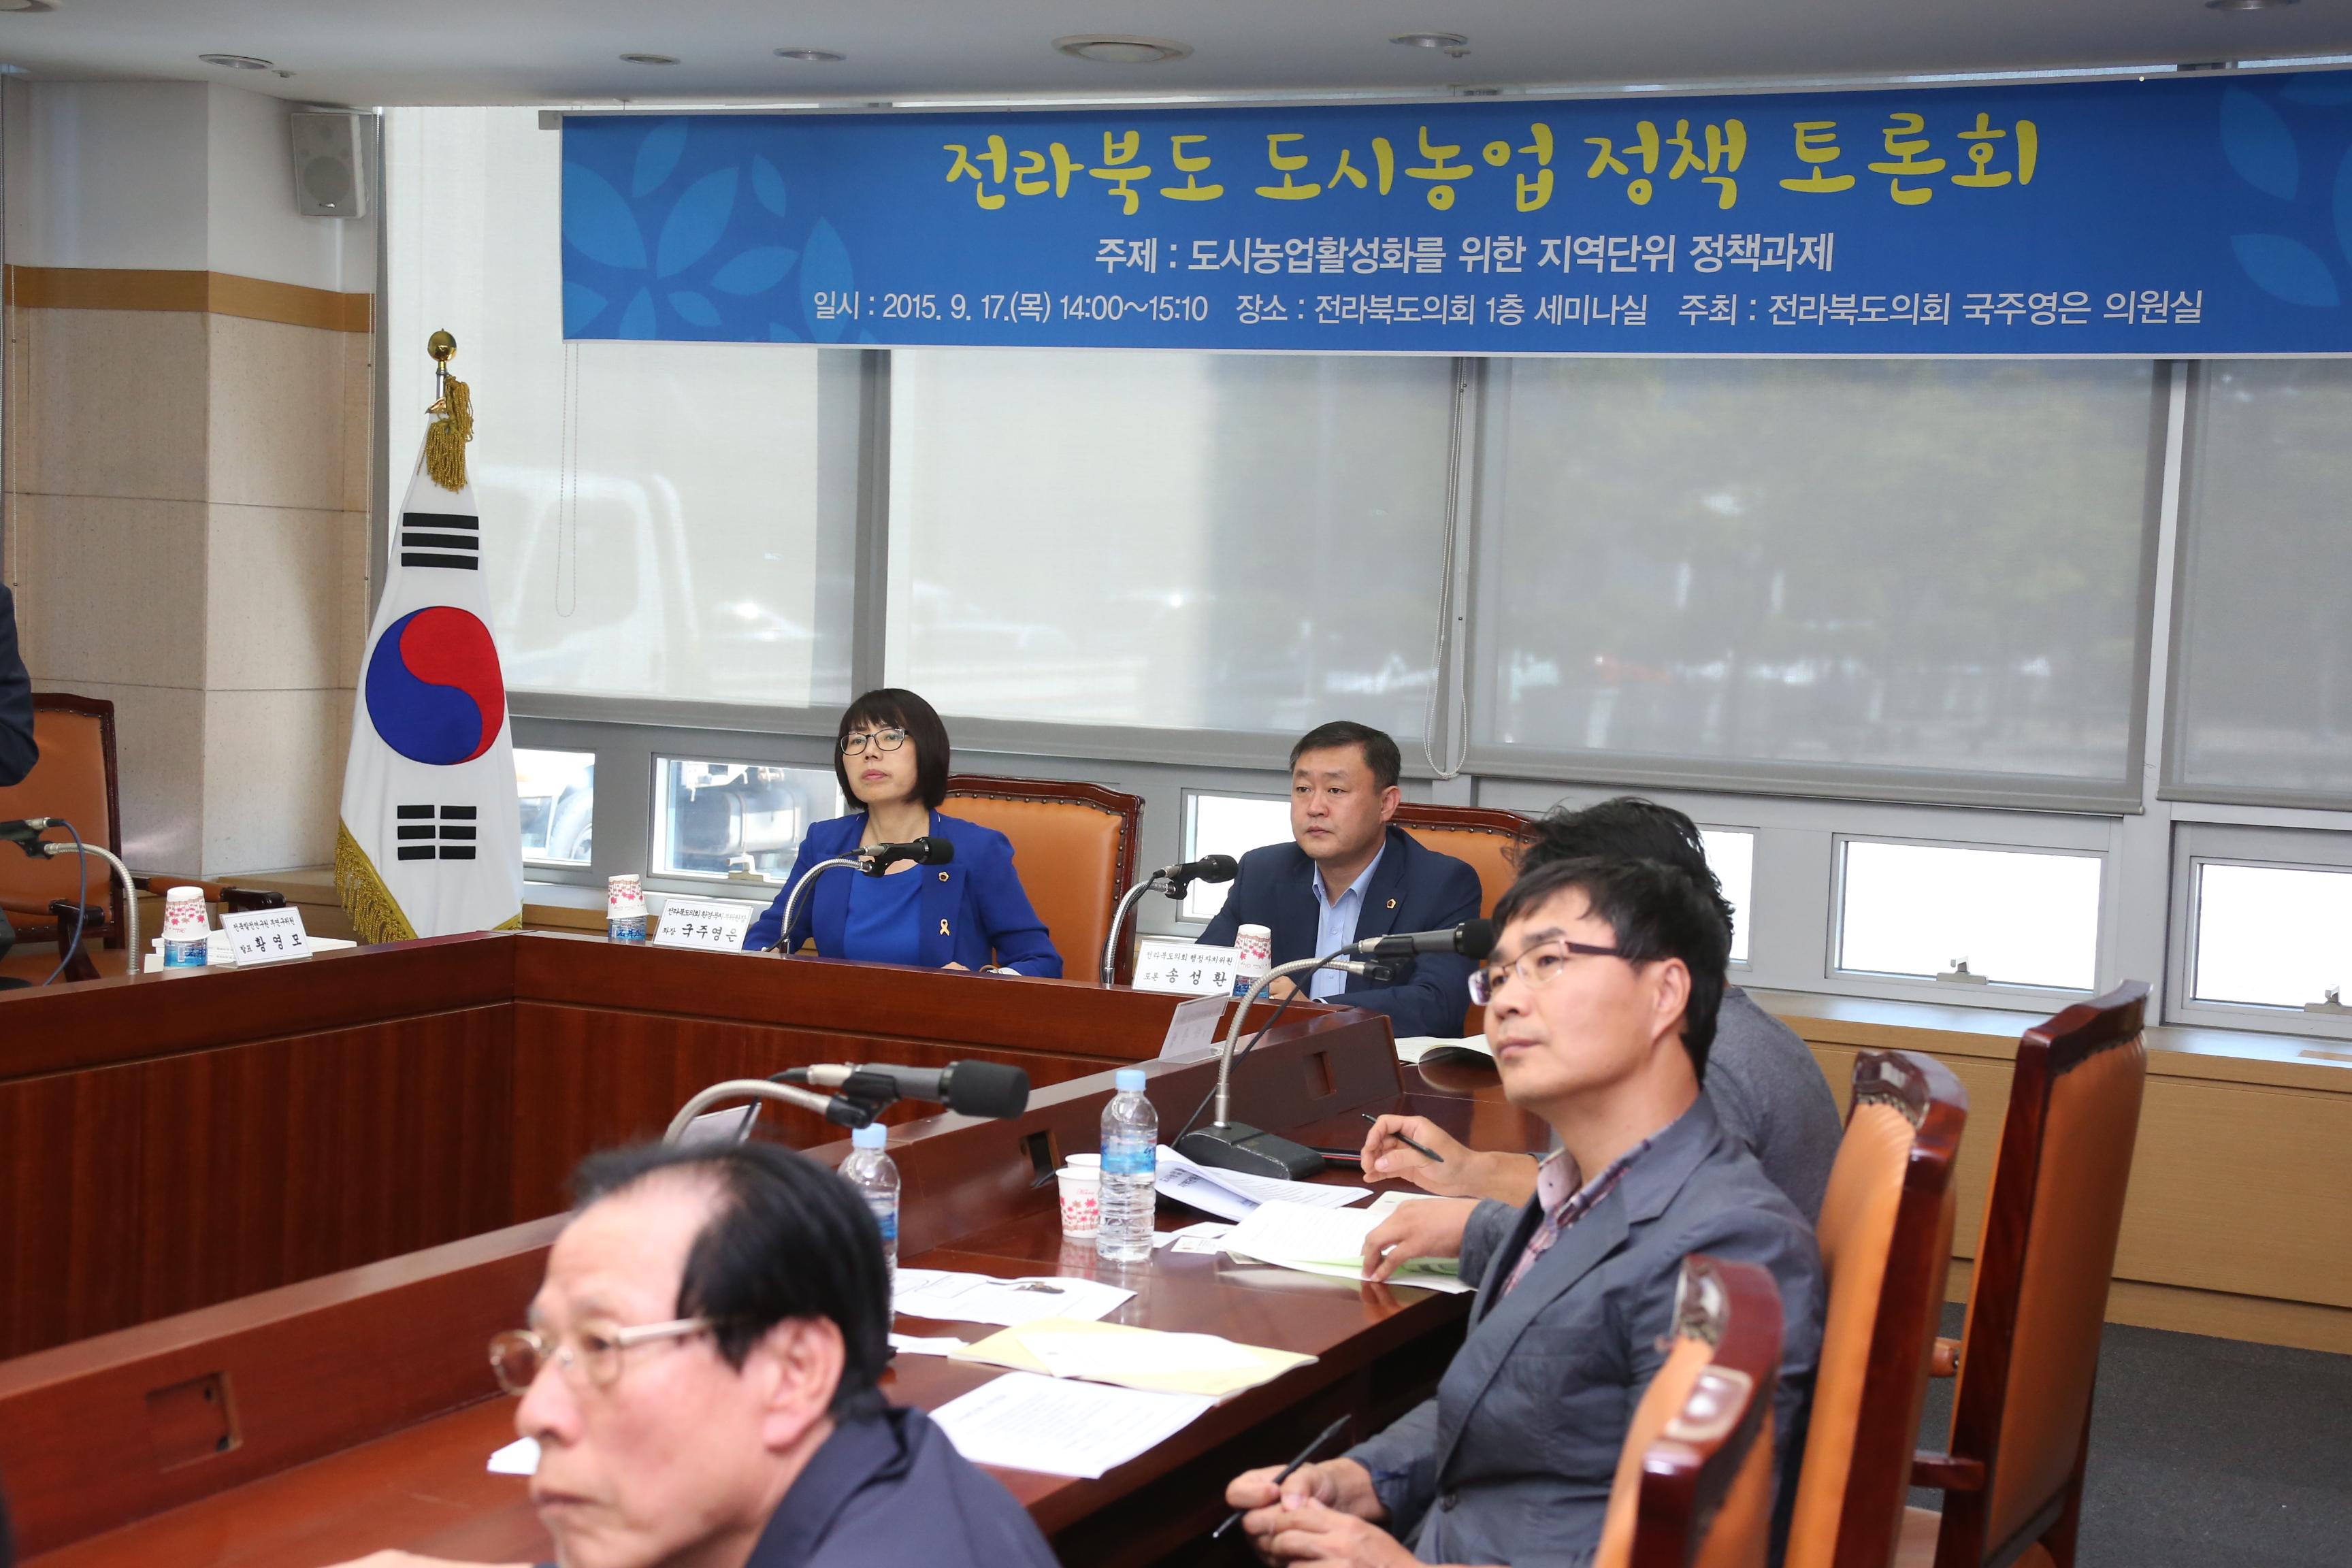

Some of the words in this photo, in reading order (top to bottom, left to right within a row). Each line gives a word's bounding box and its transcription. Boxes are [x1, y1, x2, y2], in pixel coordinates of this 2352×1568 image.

[943, 130, 1224, 215] 전라북도
[1256, 122, 1554, 212] 도시농업
[1584, 118, 1747, 210] 정책
[1779, 112, 2038, 206] 토론회
[1096, 238, 1158, 274] 주제
[1188, 237, 1448, 275] 도시농업활성화를
[1459, 236, 1527, 274] 위한
[1538, 235, 1676, 274] 지역단위
[1690, 233, 1835, 274] 정책과제
[814, 291, 860, 321] 일시
[883, 293, 942, 321] 2015.
[951, 294, 972, 321] 9.
[981, 291, 1051, 324] 17.(목)
[1060, 295, 1209, 322] 14:00~15:10
[1237, 294, 1289, 325] 장소
[1316, 295, 1475, 326] 전라북도의회
[1486, 294, 1526, 327] 1층
[1535, 295, 1648, 326] 세미나실
[1679, 294, 1737, 327] 주최
[1769, 293, 1951, 327] 전라북도의회
[1963, 292, 2092, 326] 국주영은
[2104, 291, 2203, 325] 의원실
[667, 907, 701, 917] 전라북도의회
[240, 945, 253, 954] 발표
[1146, 951, 1188, 962] 전라북도의회
[1190, 953, 1233, 966] 행정자치위원
[1143, 972, 1159, 981] 토론
